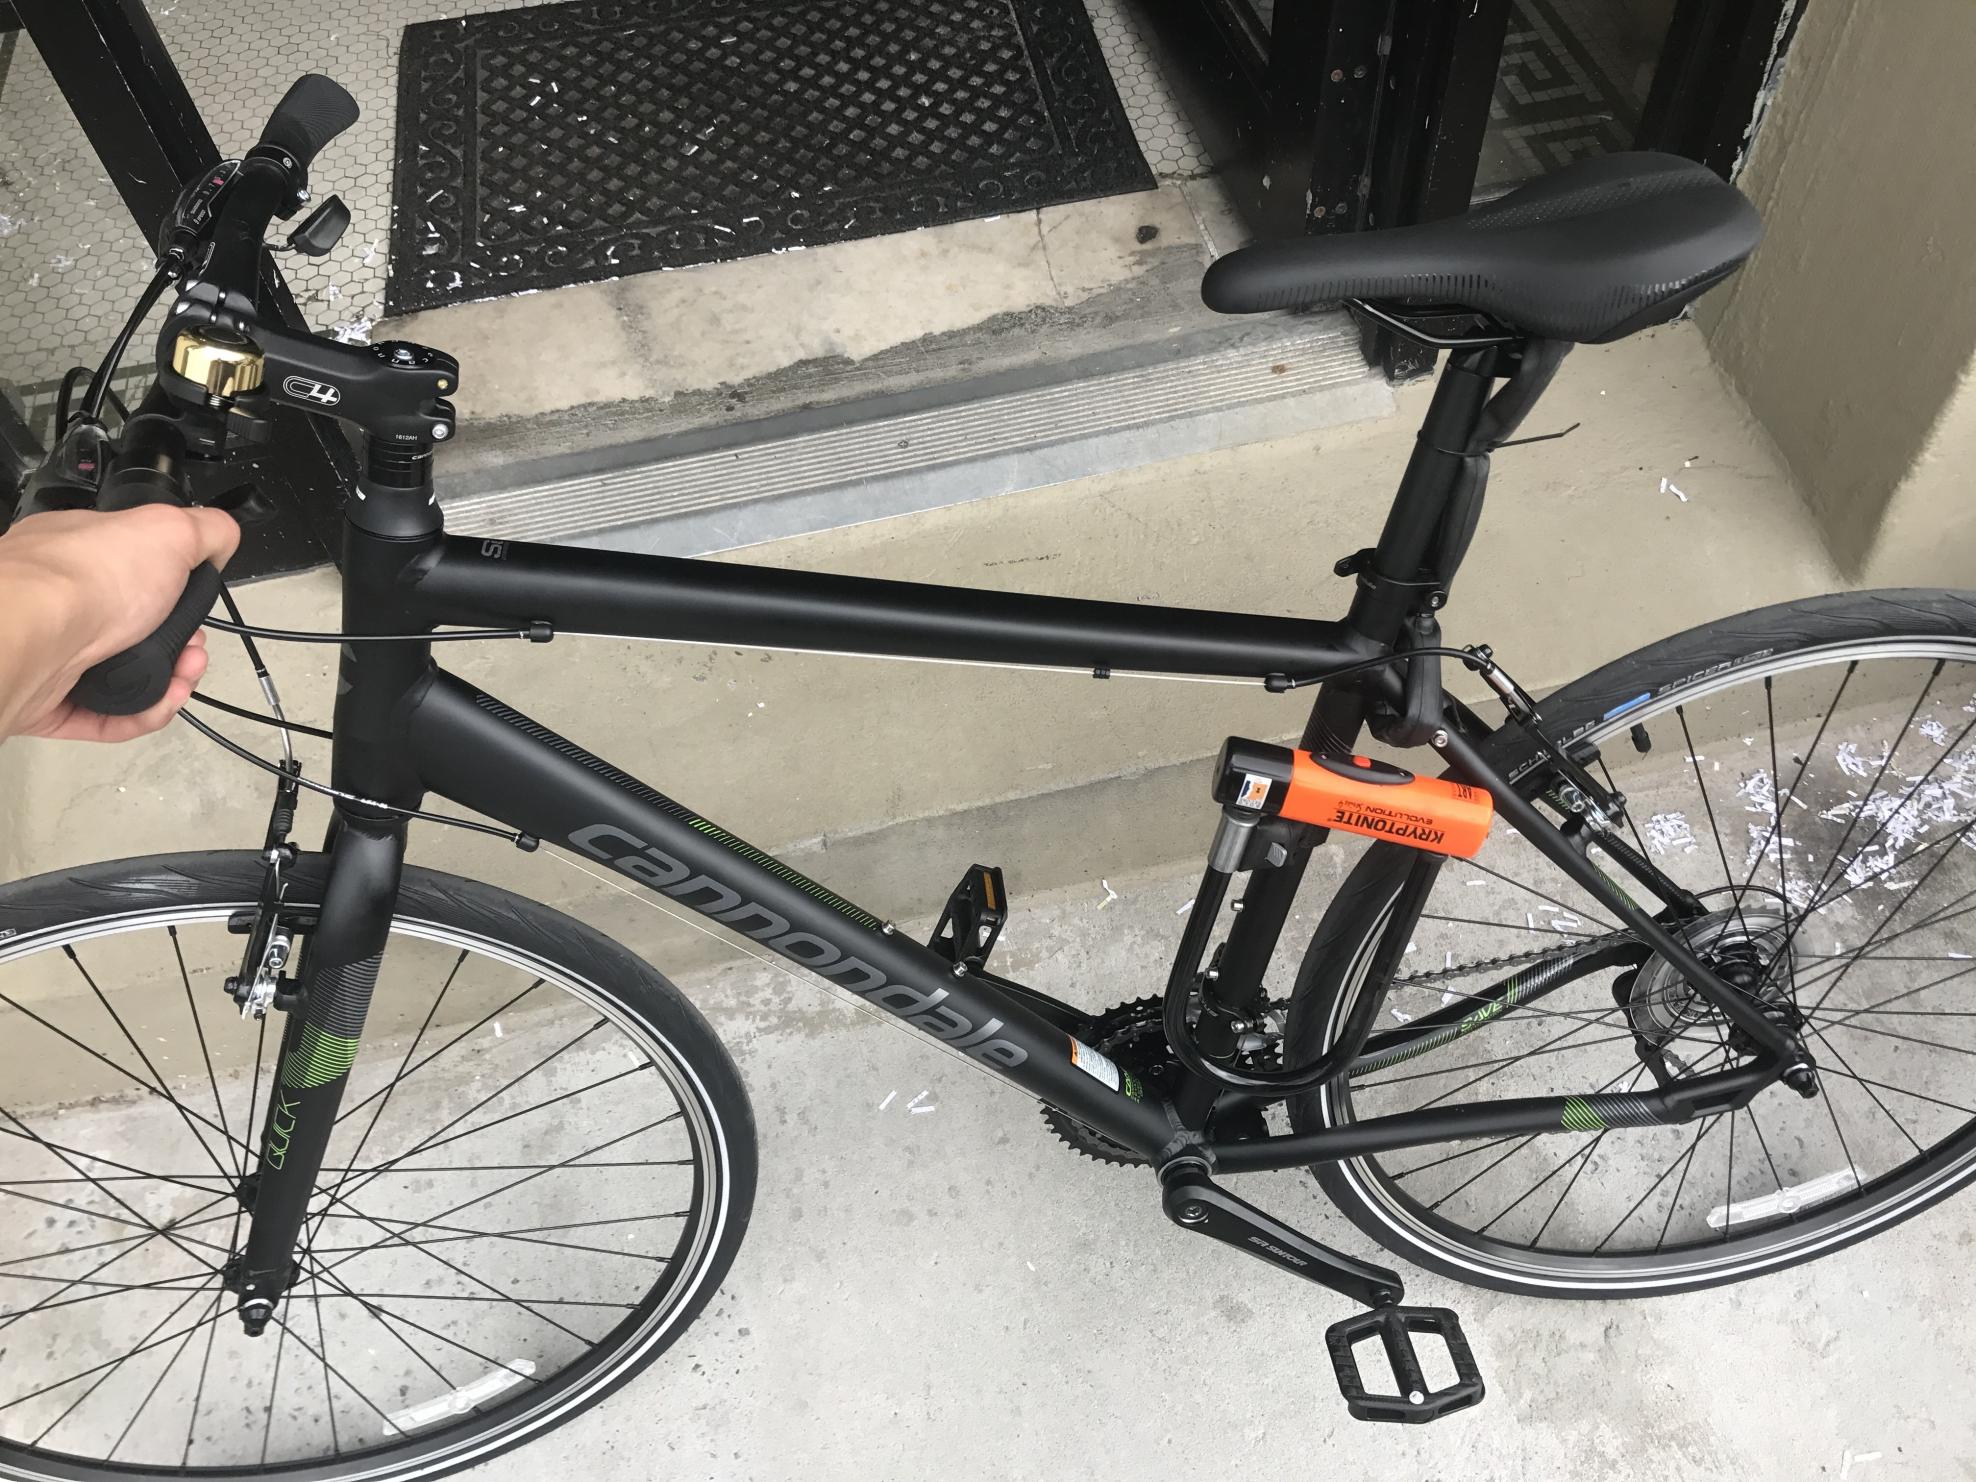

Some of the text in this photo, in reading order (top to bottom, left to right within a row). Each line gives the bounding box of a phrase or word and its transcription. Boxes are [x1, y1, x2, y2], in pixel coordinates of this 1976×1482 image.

[1365, 805, 1433, 825] EVOLUTION
[1333, 809, 1446, 845] KRYPTONITE
[1266, 1244, 1308, 1267] SUNTOUR
